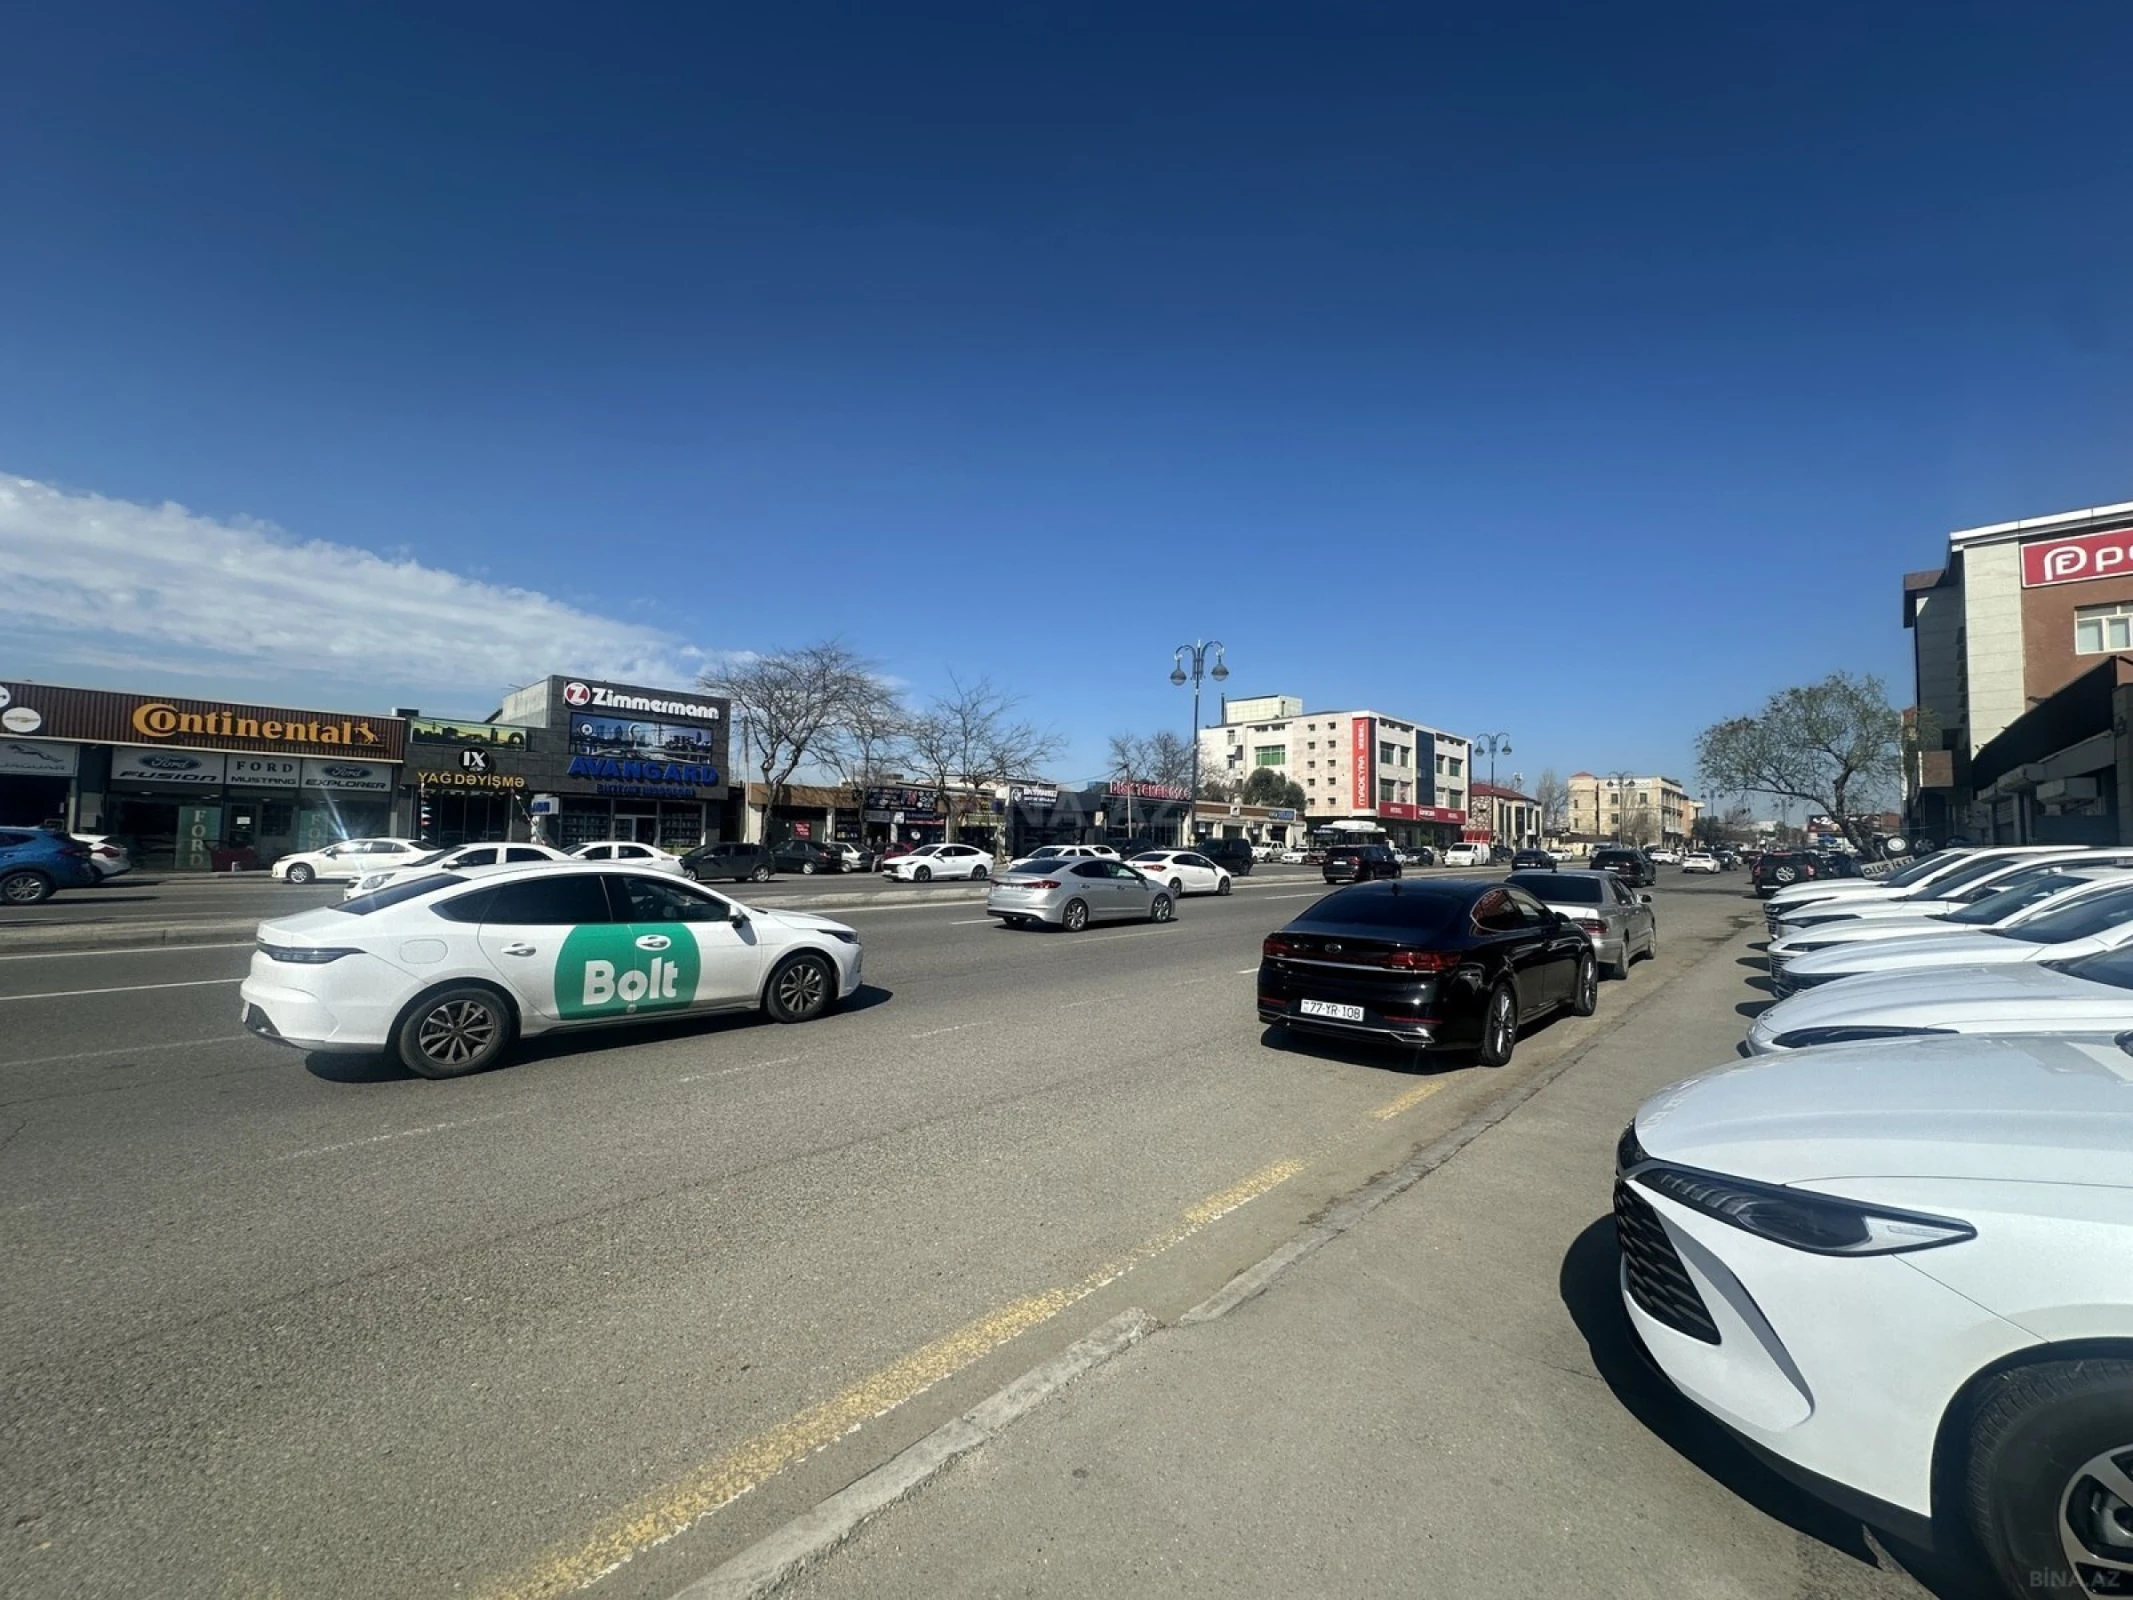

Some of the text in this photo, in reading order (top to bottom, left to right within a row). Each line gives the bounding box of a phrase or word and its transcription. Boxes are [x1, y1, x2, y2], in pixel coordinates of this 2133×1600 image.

[591, 687, 720, 719] Zimmermann
[132, 703, 353, 745] Continental
[236, 760, 294, 773] FORD
[567, 756, 720, 787] AVANGARD
[231, 776, 297, 785] MUSTANG
[305, 778, 387, 789] EXPLORER
[418, 771, 525, 789] YAĞ DƏYİŞMƏ
[583, 956, 679, 1006] Bolt
